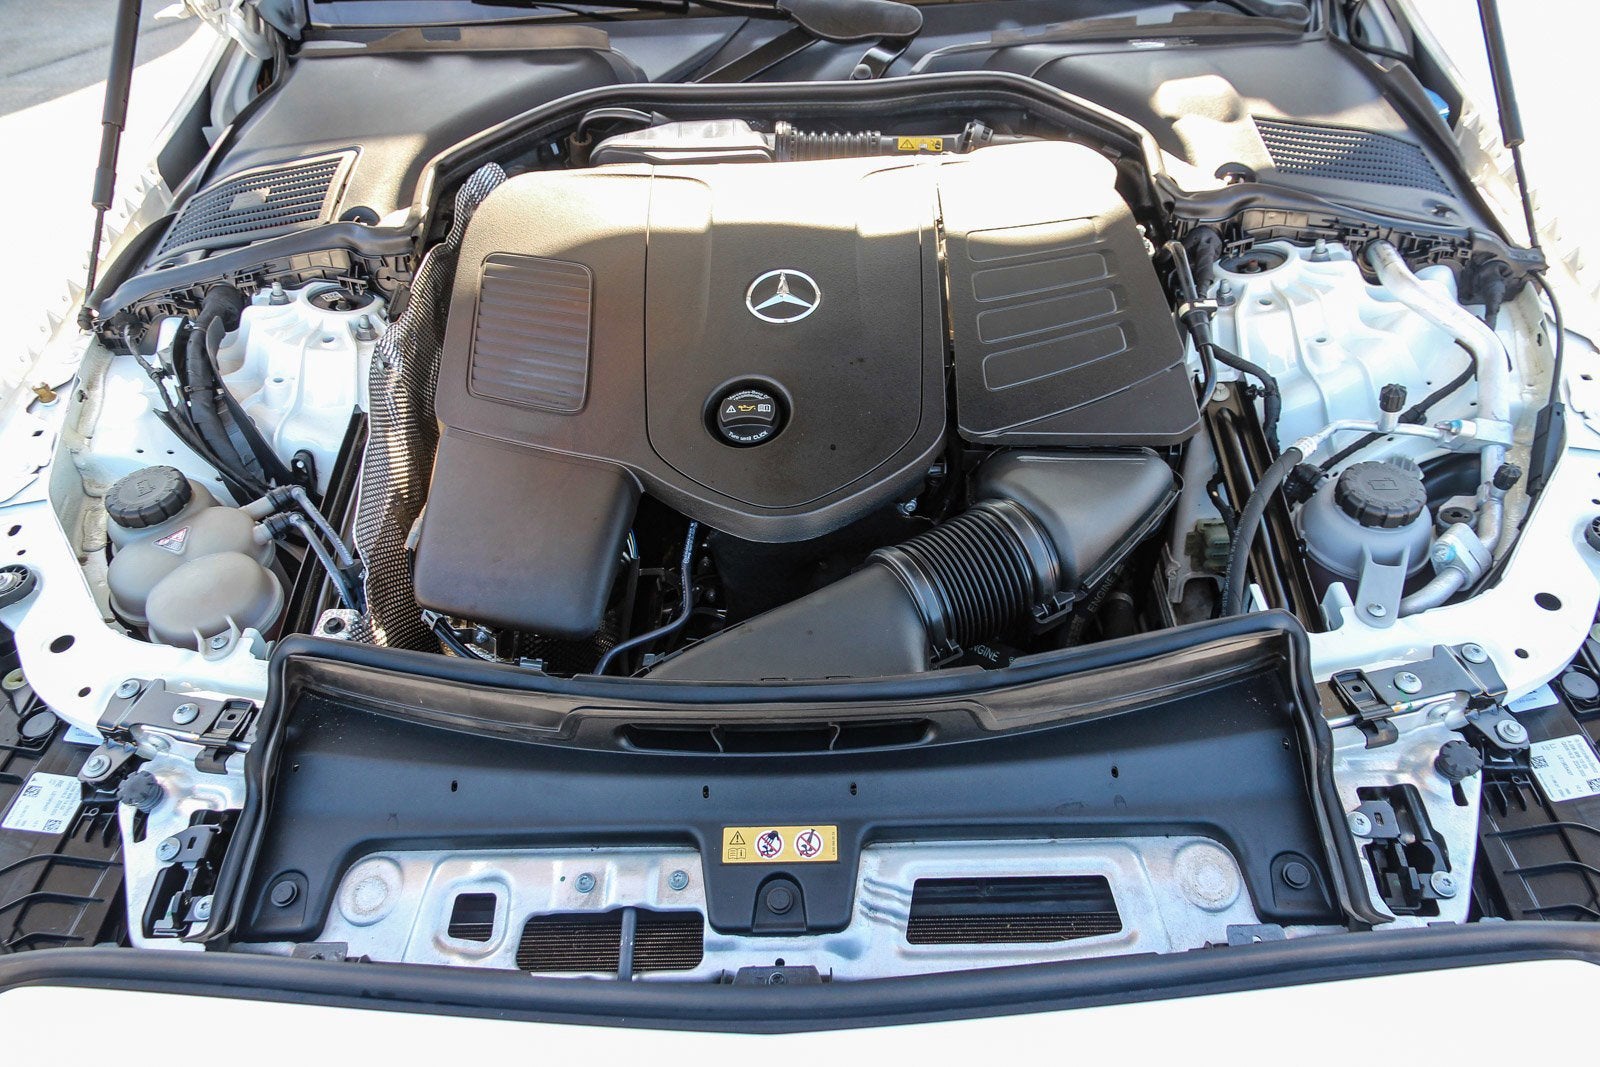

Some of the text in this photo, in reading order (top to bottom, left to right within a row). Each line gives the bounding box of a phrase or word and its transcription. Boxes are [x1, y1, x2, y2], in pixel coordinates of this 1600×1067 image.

[752, 430, 769, 440] CLICK
[1087, 574, 1116, 613] ENGINE
[970, 644, 1001, 662] NGINE
